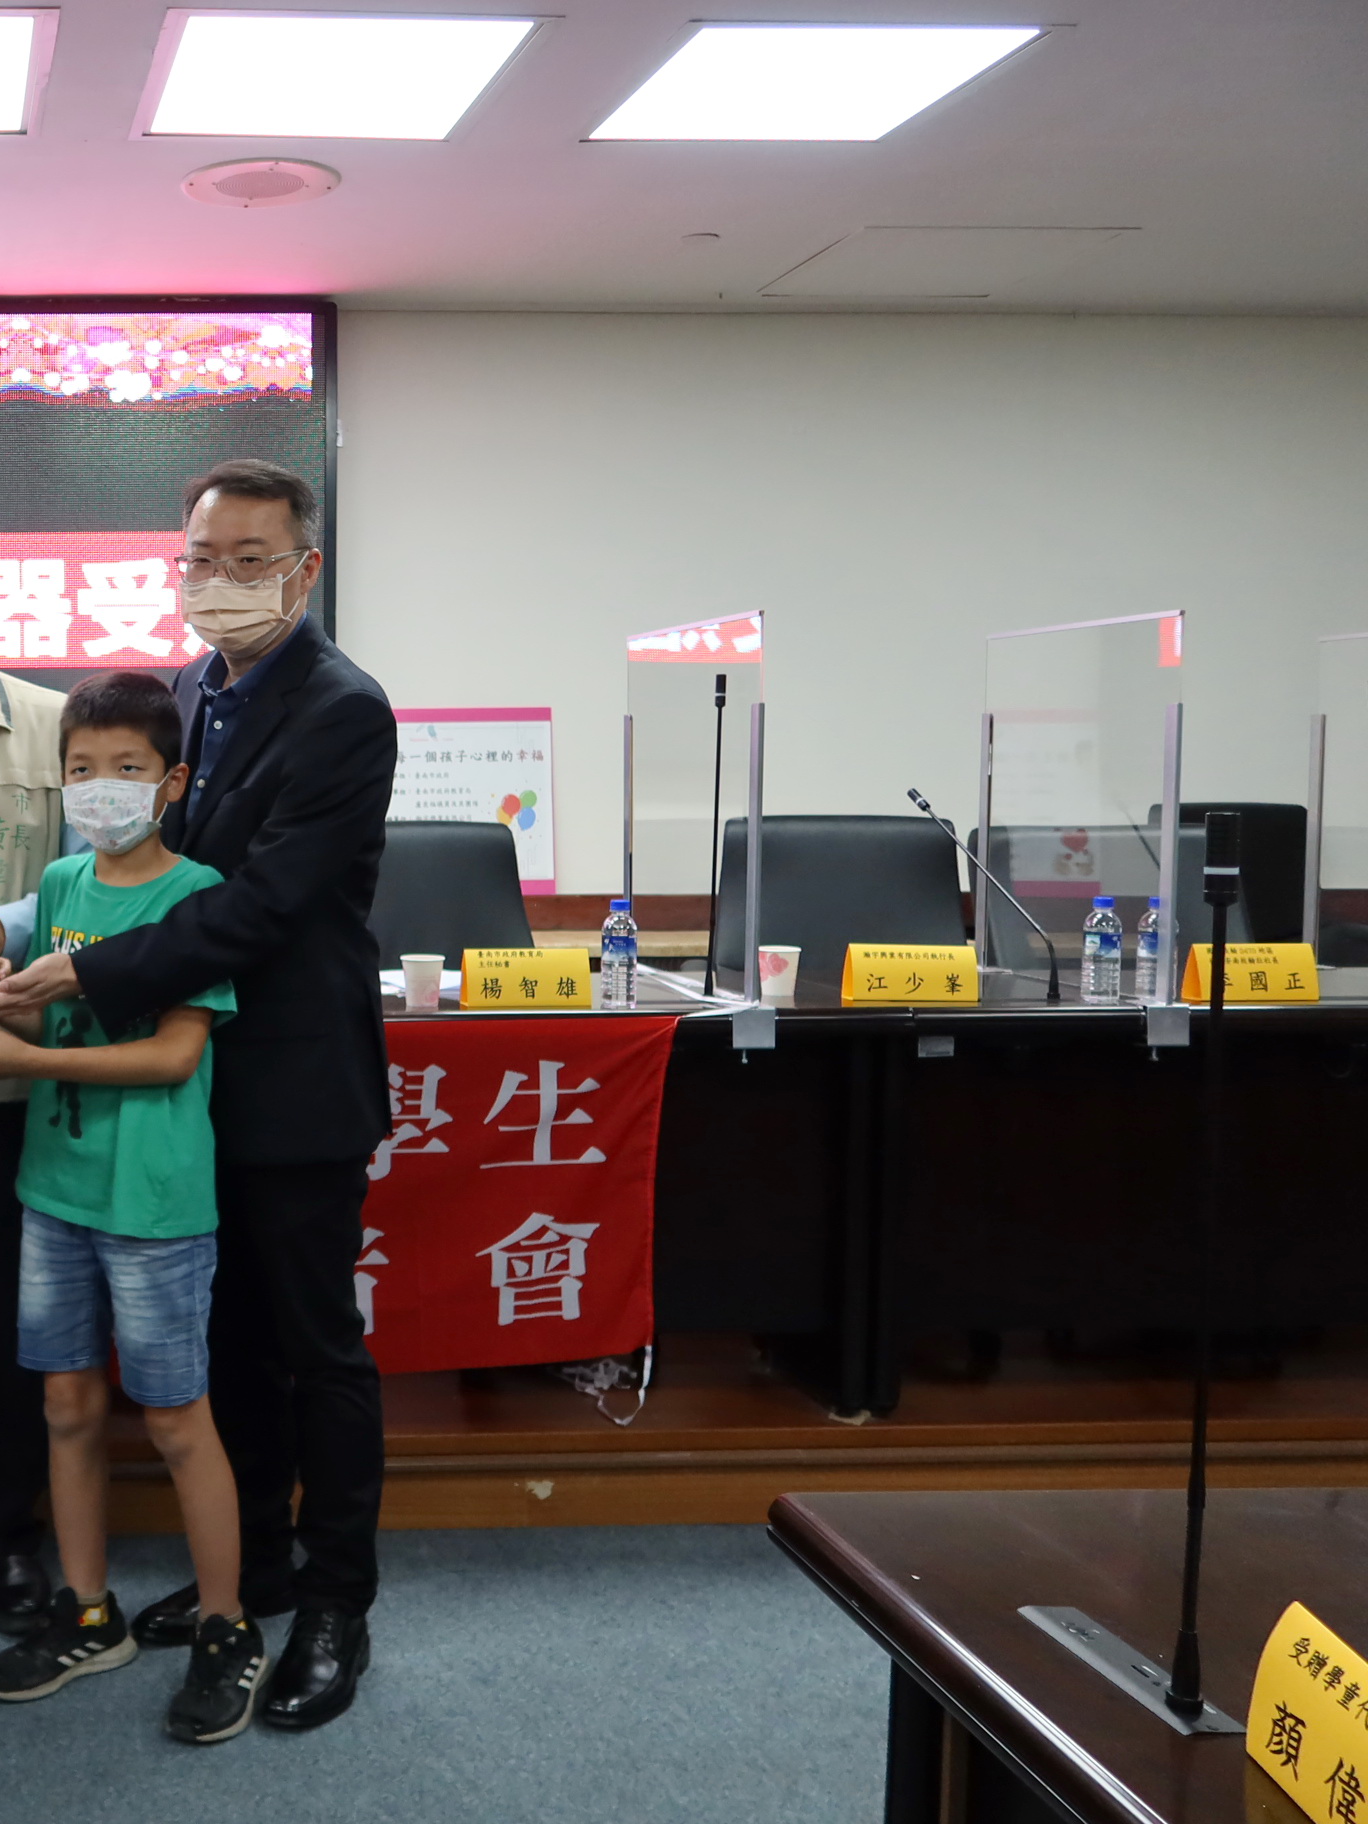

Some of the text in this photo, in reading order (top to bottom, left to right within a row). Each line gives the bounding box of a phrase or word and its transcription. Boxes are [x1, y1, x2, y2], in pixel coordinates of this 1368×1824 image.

[10, 792, 31, 852] 市長
[480, 976, 578, 1000] 楊智雄
[366, 1060, 607, 1181] 學生
